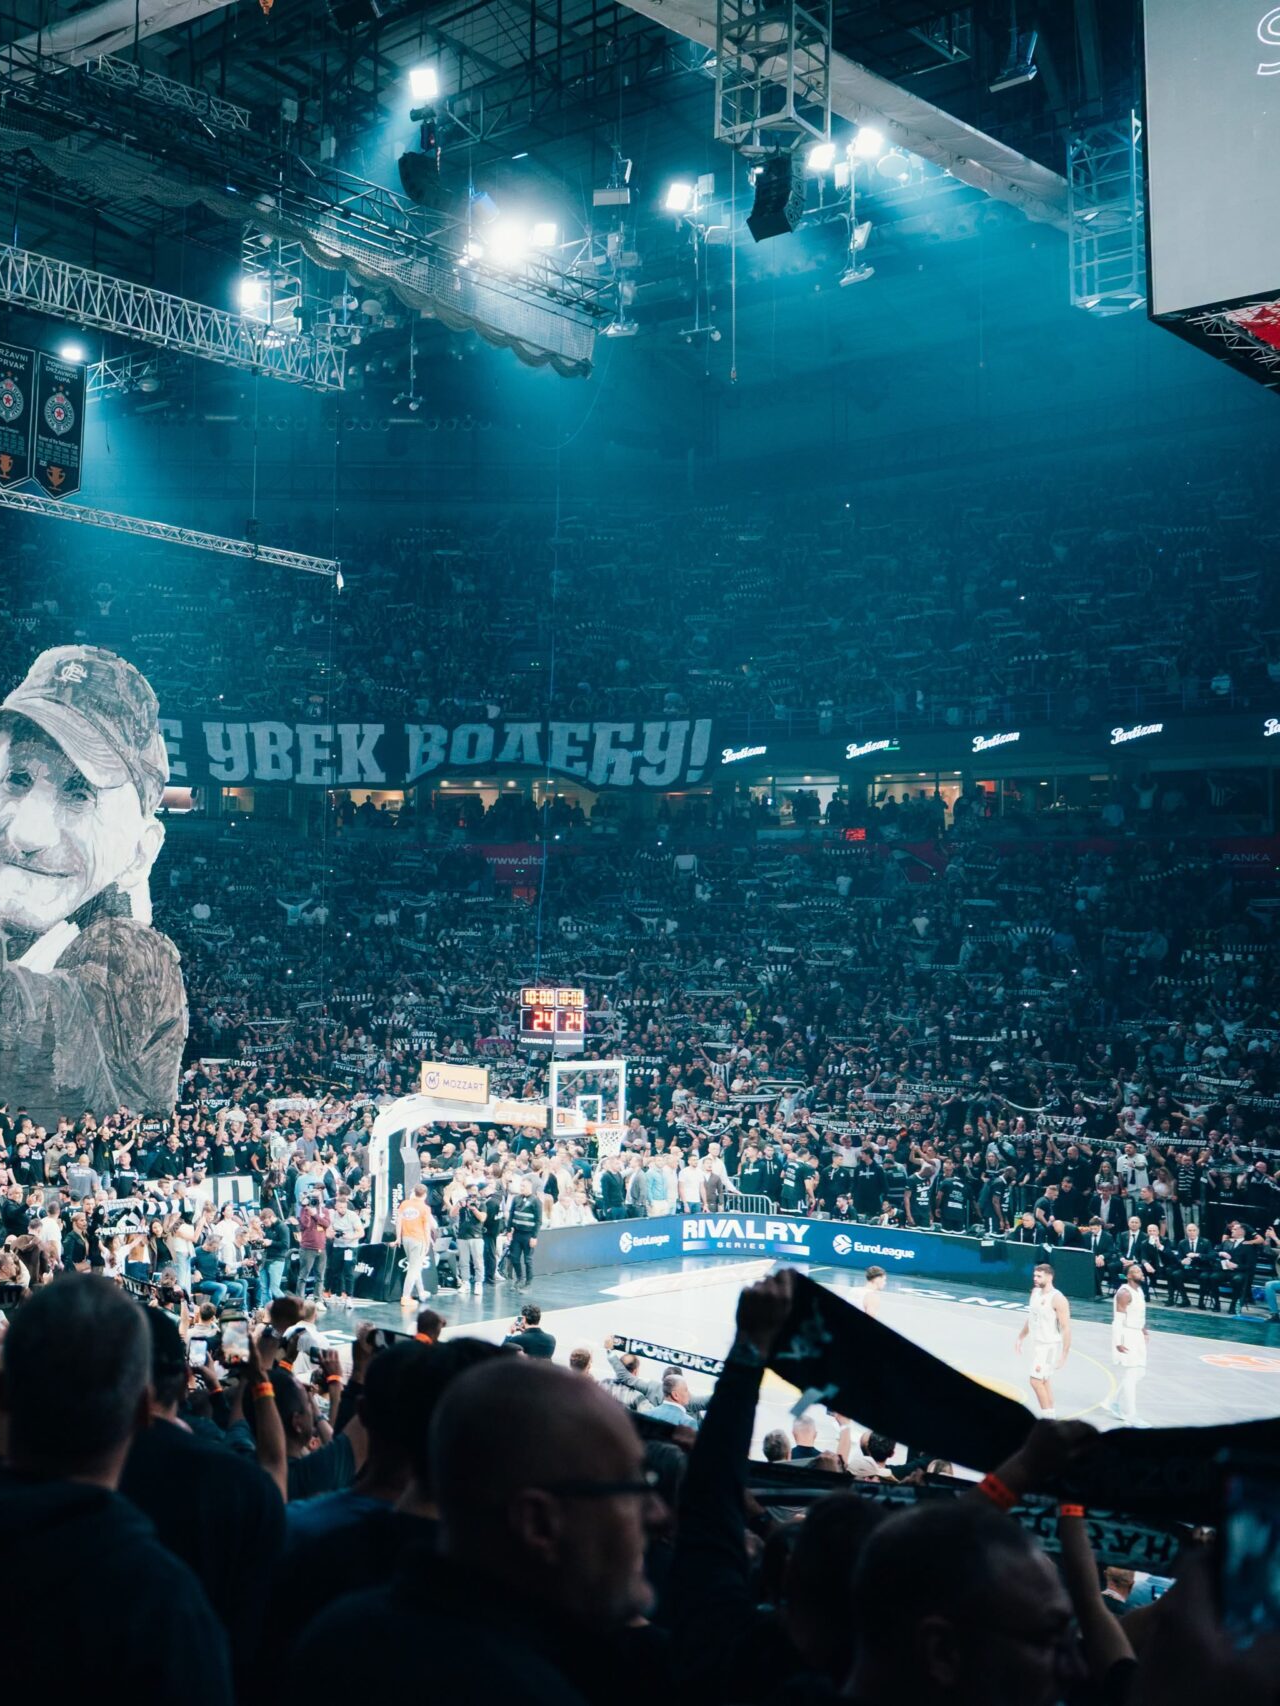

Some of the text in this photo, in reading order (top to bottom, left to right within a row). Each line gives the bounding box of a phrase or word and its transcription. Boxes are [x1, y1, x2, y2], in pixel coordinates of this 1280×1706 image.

[972, 732, 1020, 752] Partizan
[1110, 723, 1163, 745] Partizan
[202, 721, 388, 784] УВЕК
[404, 718, 712, 786] ВОЛЕЋУ!
[721, 746, 767, 764] Partizan
[846, 740, 890, 760] Partizan
[486, 856, 544, 865] www.alta
[525, 990, 582, 1006] 10:00 10:00
[533, 1011, 582, 1032] 24 24
[442, 1079, 485, 1090] MOZZART
[632, 1233, 670, 1247] EuroLeague
[682, 1219, 810, 1243] RIVALRY
[716, 1241, 765, 1250] SERIES
[854, 1241, 916, 1259] EuroLeague
